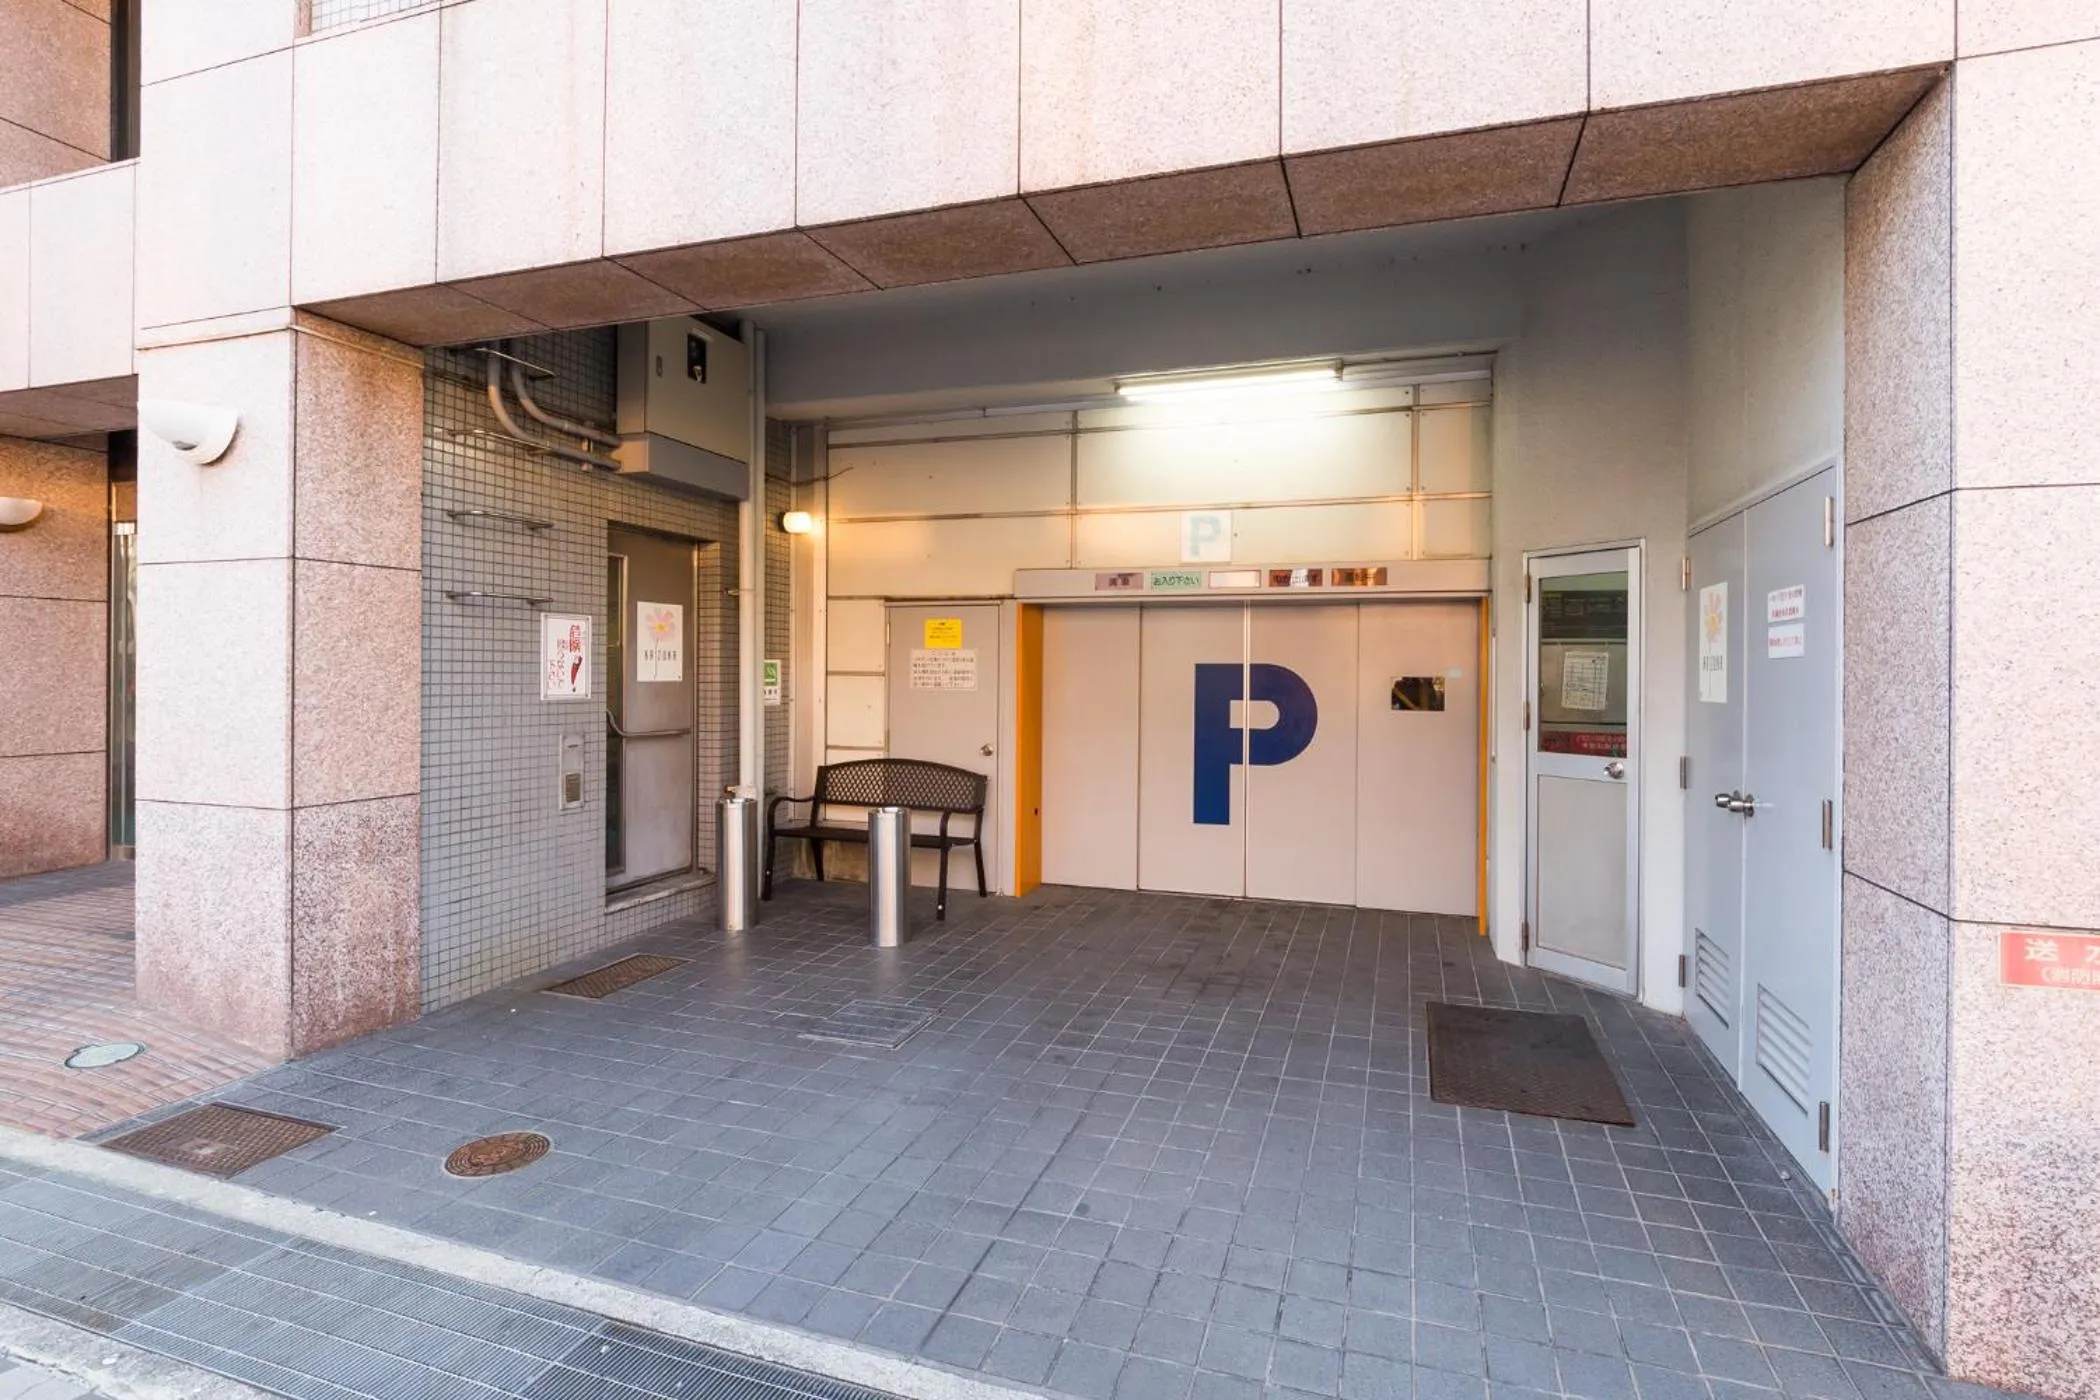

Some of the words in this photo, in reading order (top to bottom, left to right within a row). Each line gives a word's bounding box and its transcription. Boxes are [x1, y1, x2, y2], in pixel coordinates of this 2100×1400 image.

[1191, 516, 1222, 558] P
[1153, 575, 1199, 586] お入り下さい
[1194, 664, 1318, 825] P
